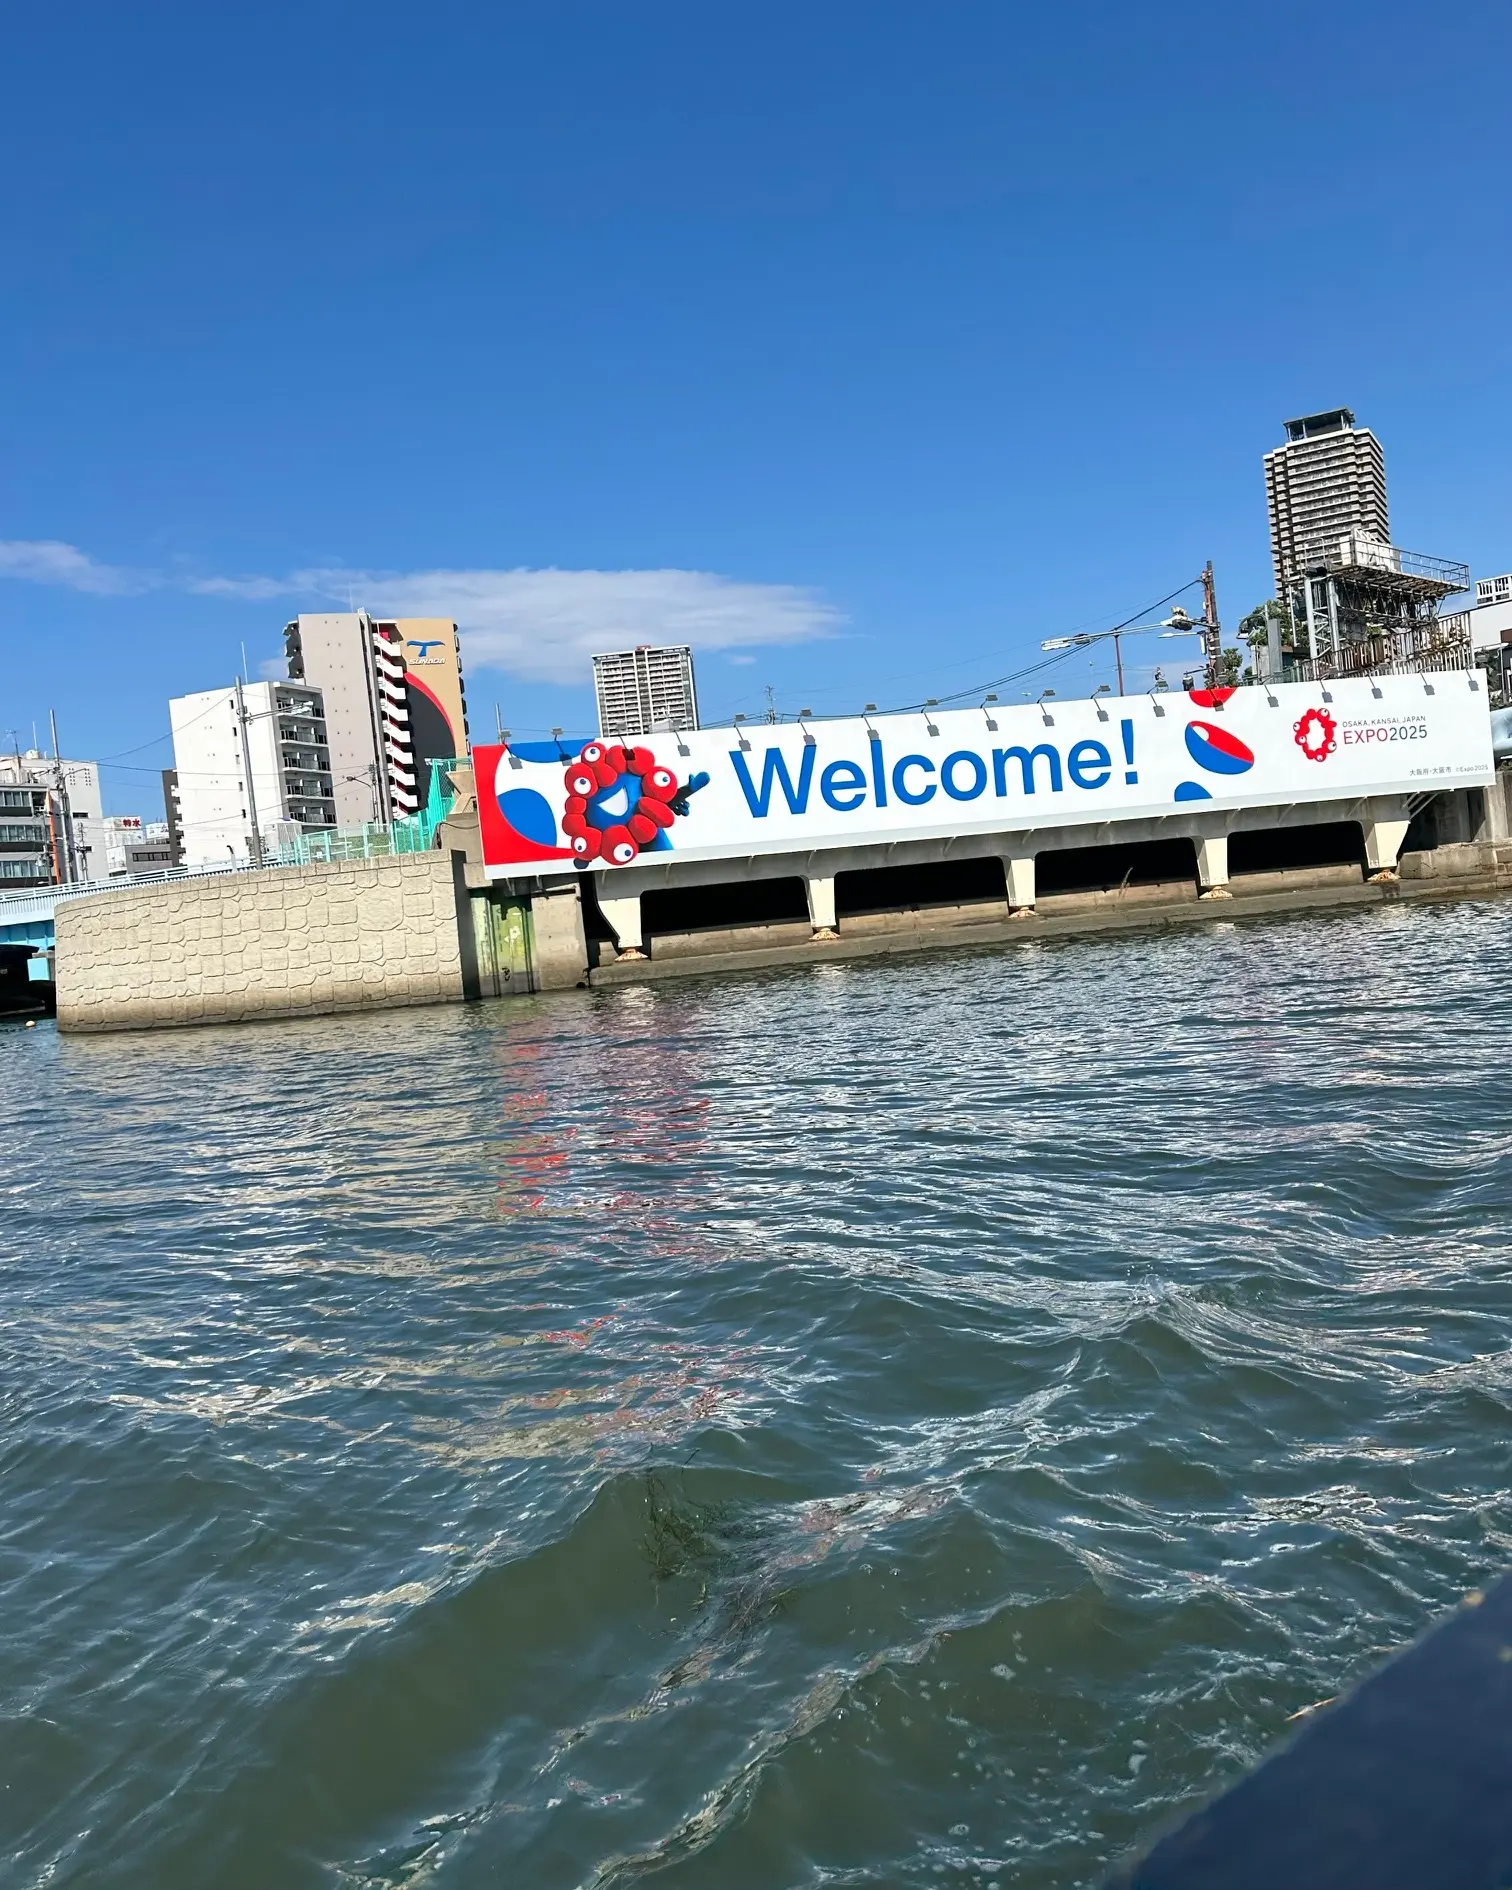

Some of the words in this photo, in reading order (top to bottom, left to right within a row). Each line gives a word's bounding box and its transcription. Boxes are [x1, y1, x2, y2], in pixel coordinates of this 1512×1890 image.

[1402, 715, 1426, 723] JAPAN
[1343, 725, 1428, 744] EXPO2025
[729, 718, 1138, 818] Welcome!
